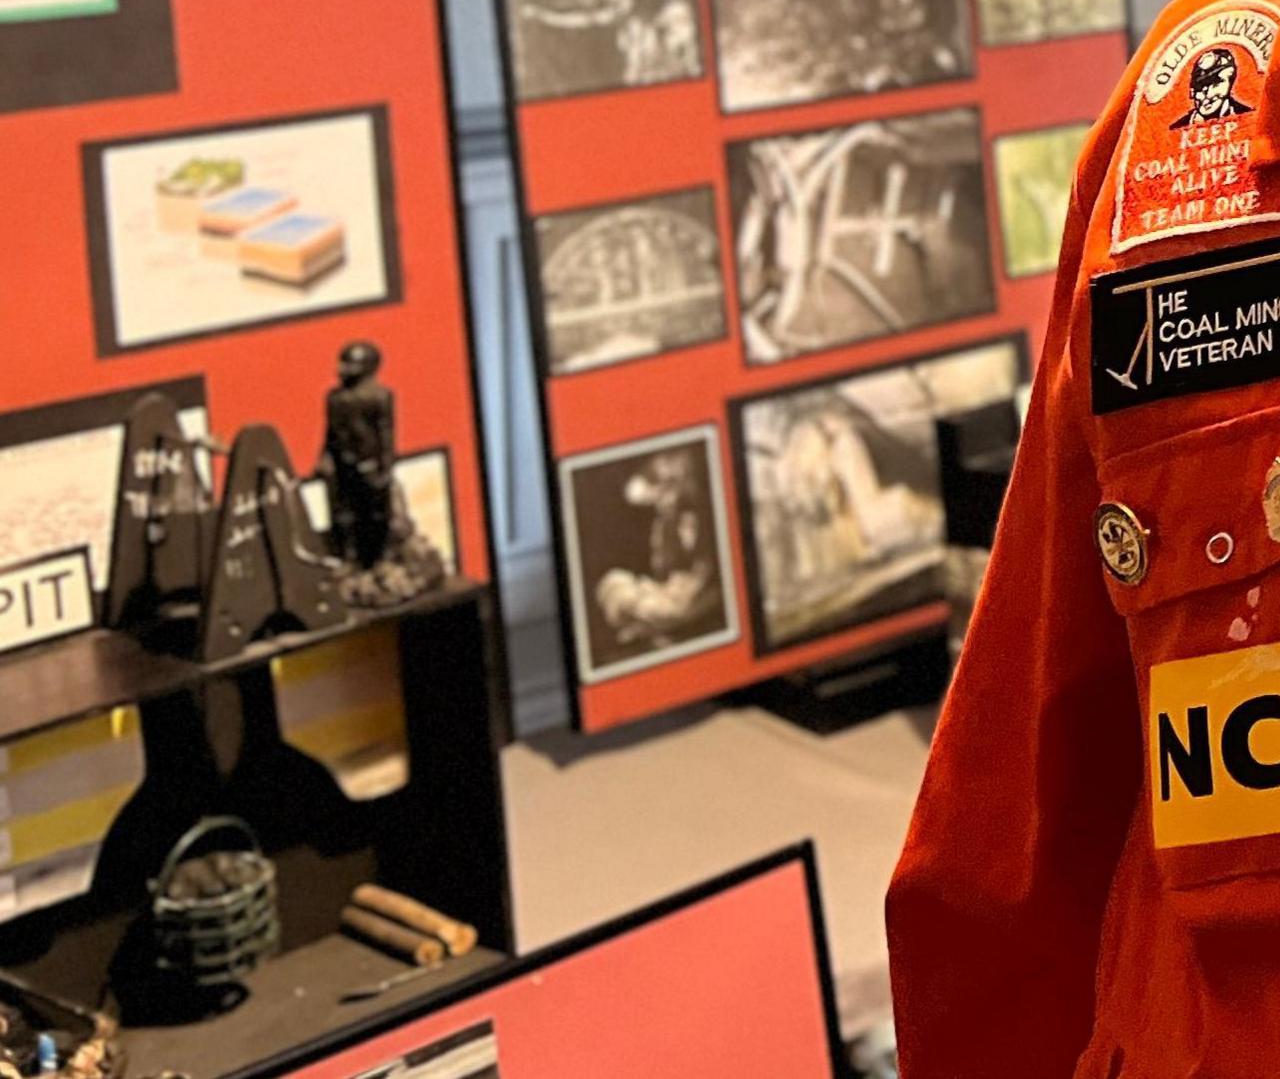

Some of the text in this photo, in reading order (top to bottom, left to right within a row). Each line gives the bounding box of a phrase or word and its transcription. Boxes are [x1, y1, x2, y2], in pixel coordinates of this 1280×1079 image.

[1156, 30, 1201, 85] OLDE
[1180, 121, 1238, 149] KEEP
[1134, 153, 1189, 182] COAL
[1171, 165, 1239, 195] ALIVE
[1141, 191, 1261, 229] TEAM ONE
[1158, 317, 1229, 344] COAL
[1158, 330, 1273, 372] VETERAN
